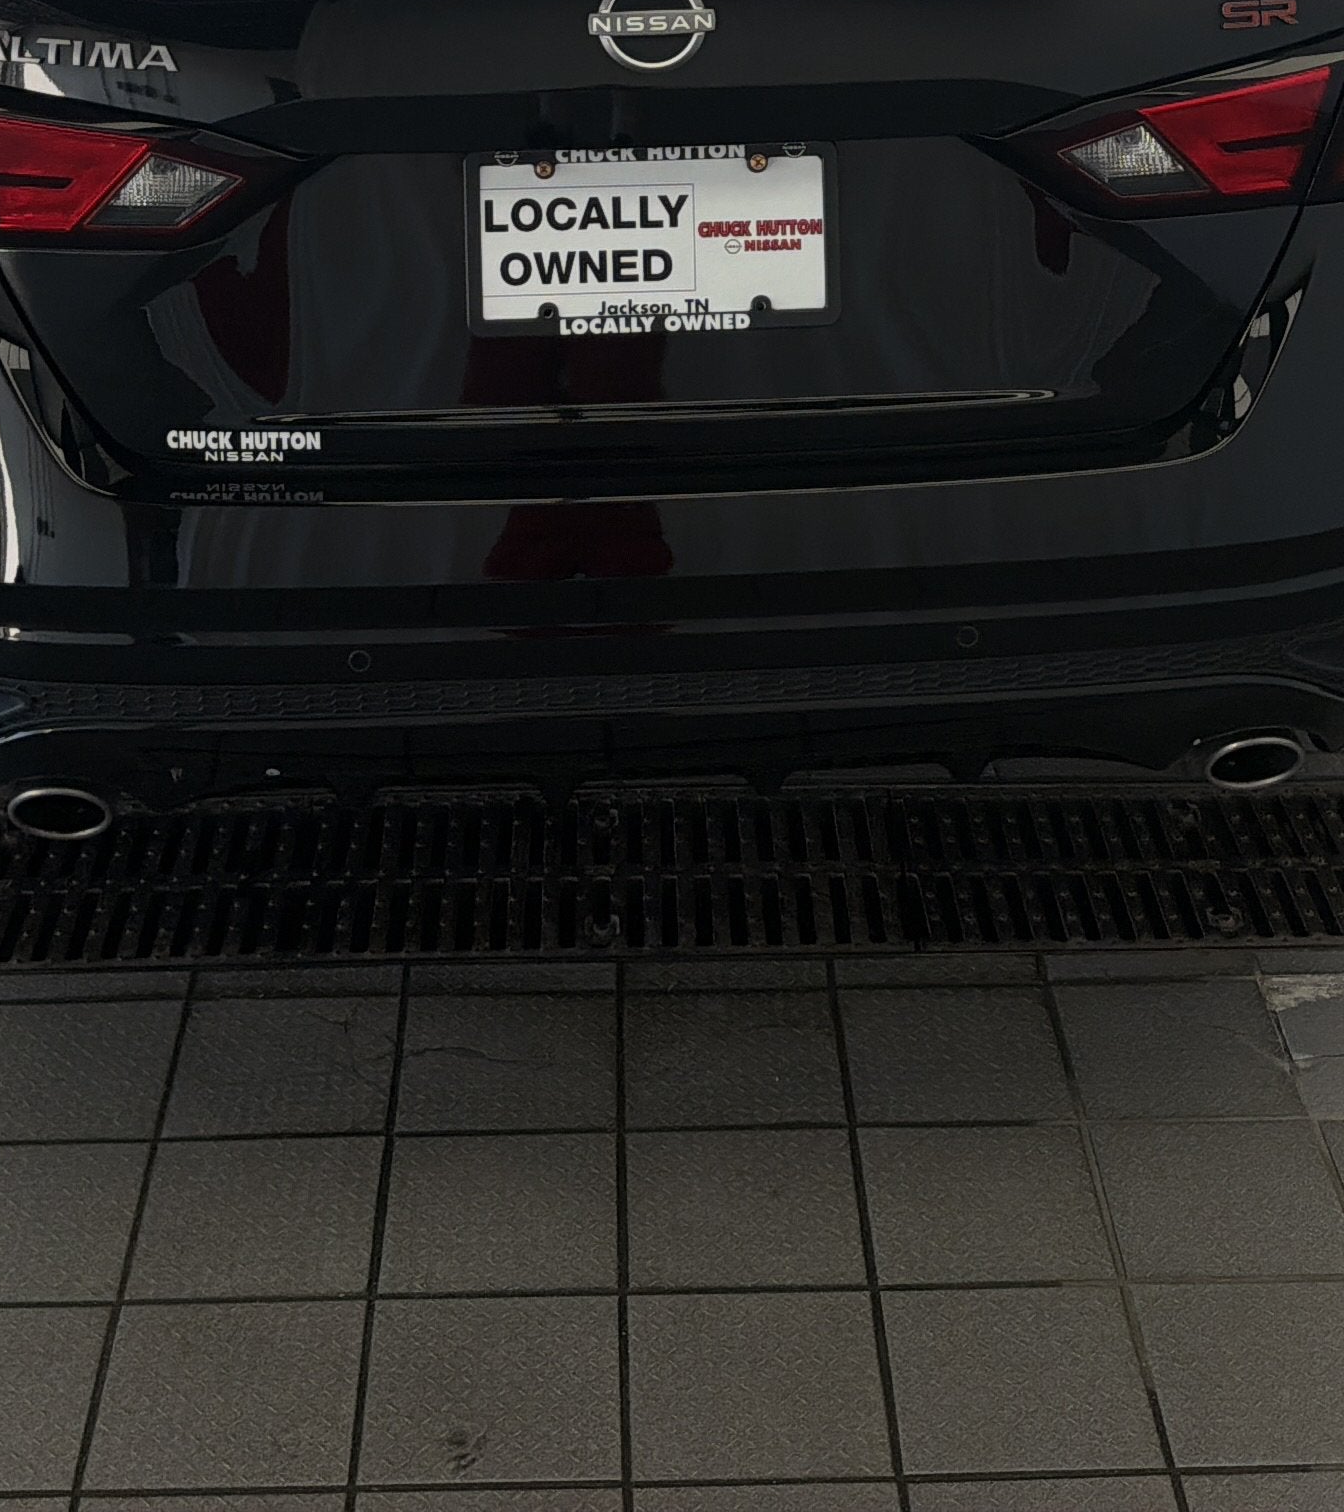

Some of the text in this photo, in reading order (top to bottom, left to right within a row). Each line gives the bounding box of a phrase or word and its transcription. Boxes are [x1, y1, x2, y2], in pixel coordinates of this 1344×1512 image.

[592, 14, 713, 33] NISSAN
[556, 144, 746, 164] CHUCK HUTTON
[484, 194, 689, 233] LOCALLY
[698, 219, 823, 238] CHUCK HUTTON
[744, 239, 802, 252] NISSAN
[500, 249, 673, 286] OWNED
[598, 298, 709, 316] Jackson, TN
[560, 313, 751, 336] LOCALLY OWNED
[166, 430, 321, 450] CHUCK HUTTON
[205, 451, 284, 462] NISSAN
